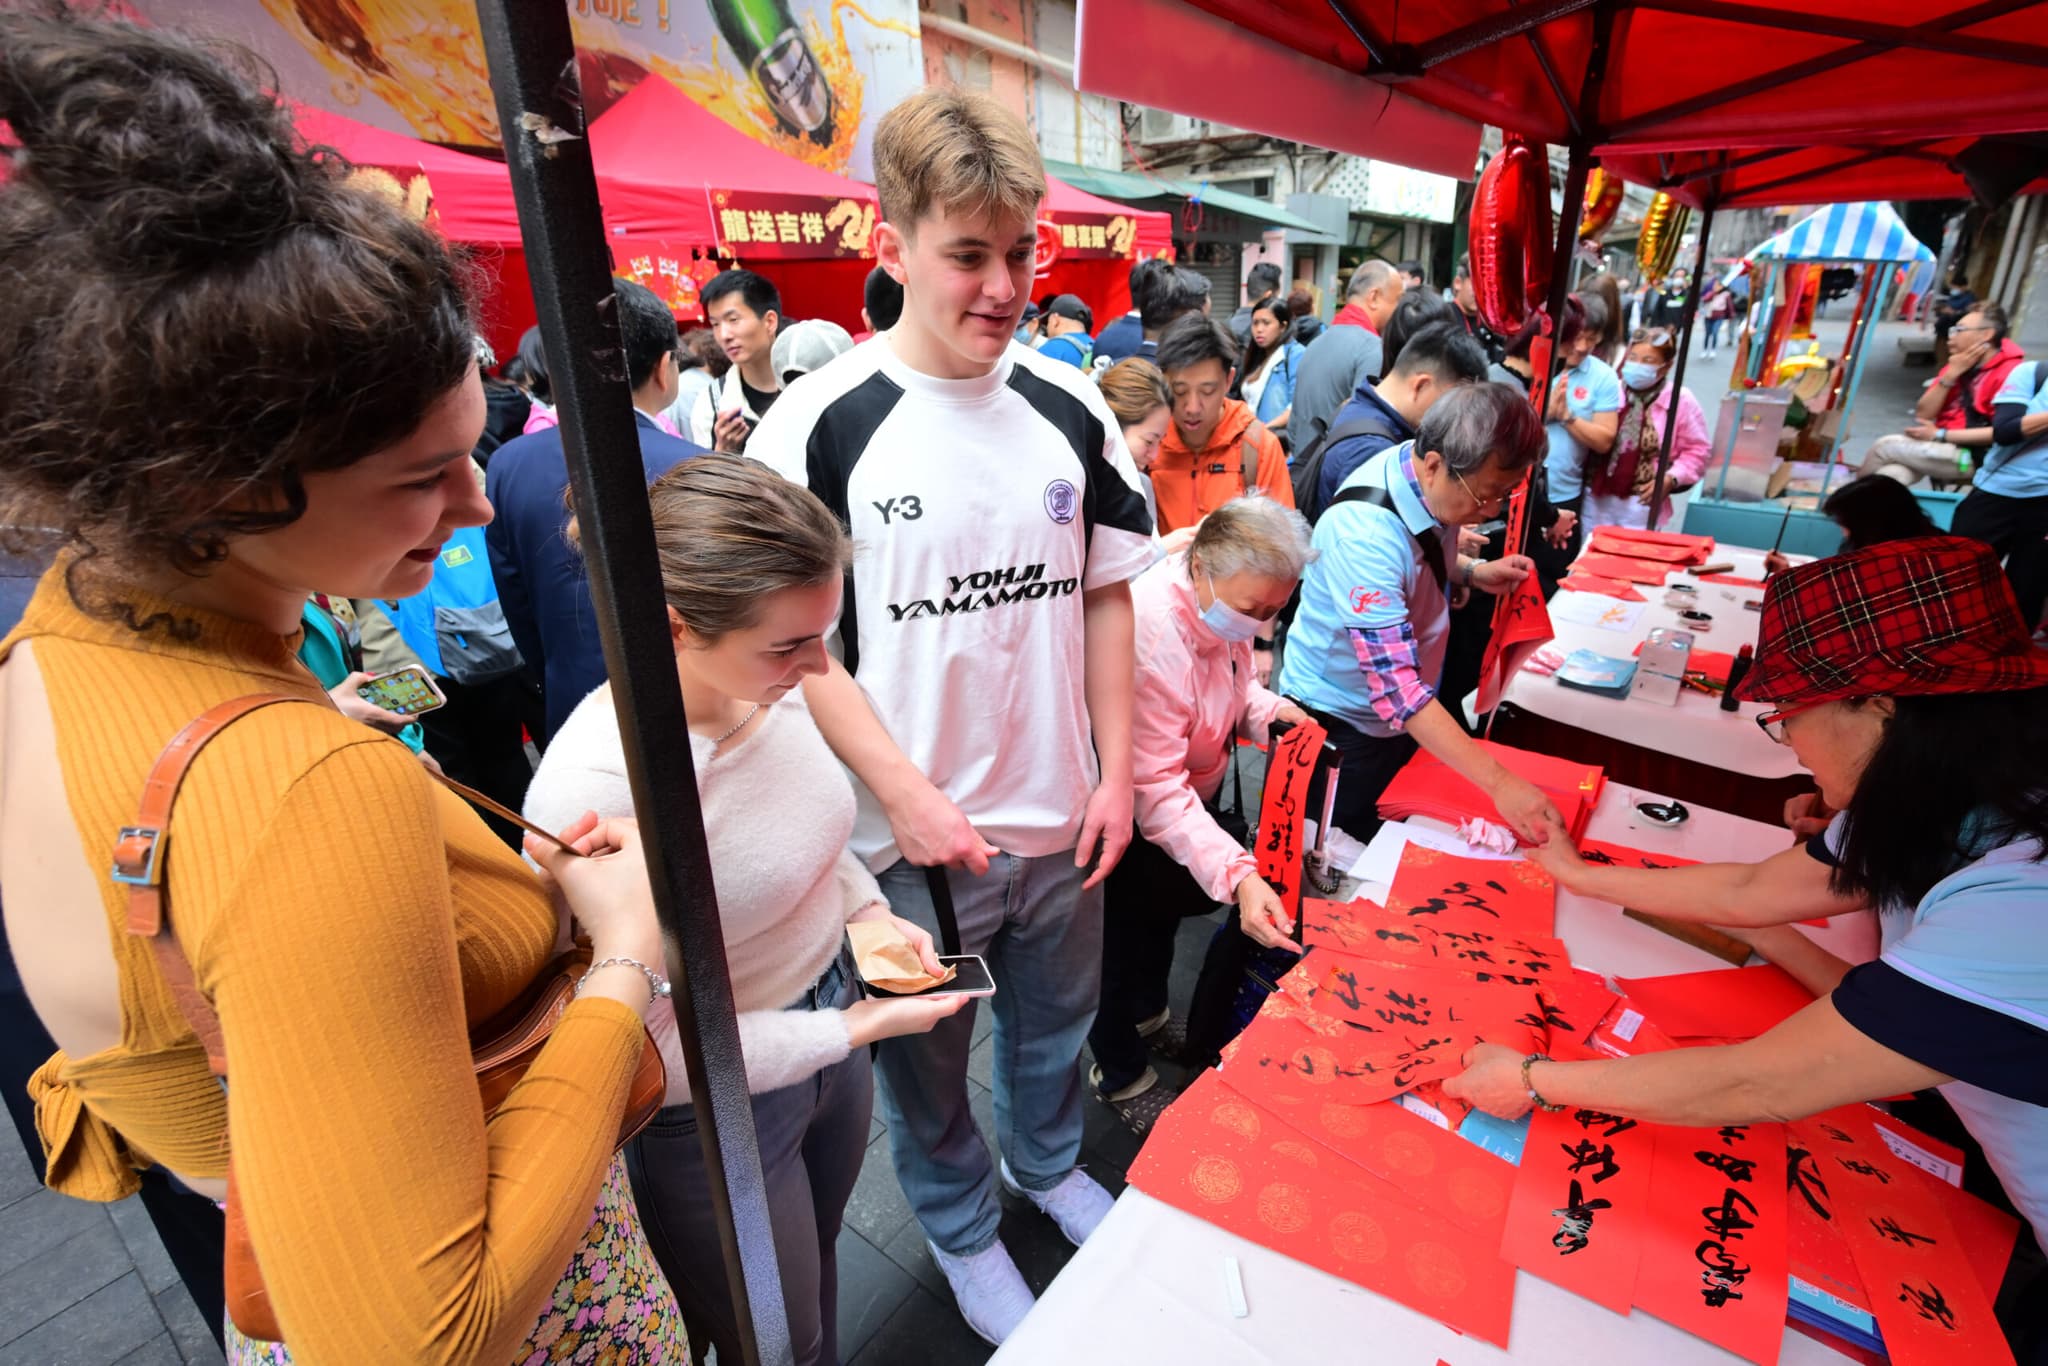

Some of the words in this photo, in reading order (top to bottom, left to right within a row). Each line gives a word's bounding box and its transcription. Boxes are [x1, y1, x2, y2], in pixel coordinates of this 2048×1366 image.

[720, 208, 825, 244] 龍送吉祥
[872, 495, 924, 525] Y-3
[949, 563, 1046, 594] YOHJI
[886, 577, 1078, 623] YAMAMOTO
